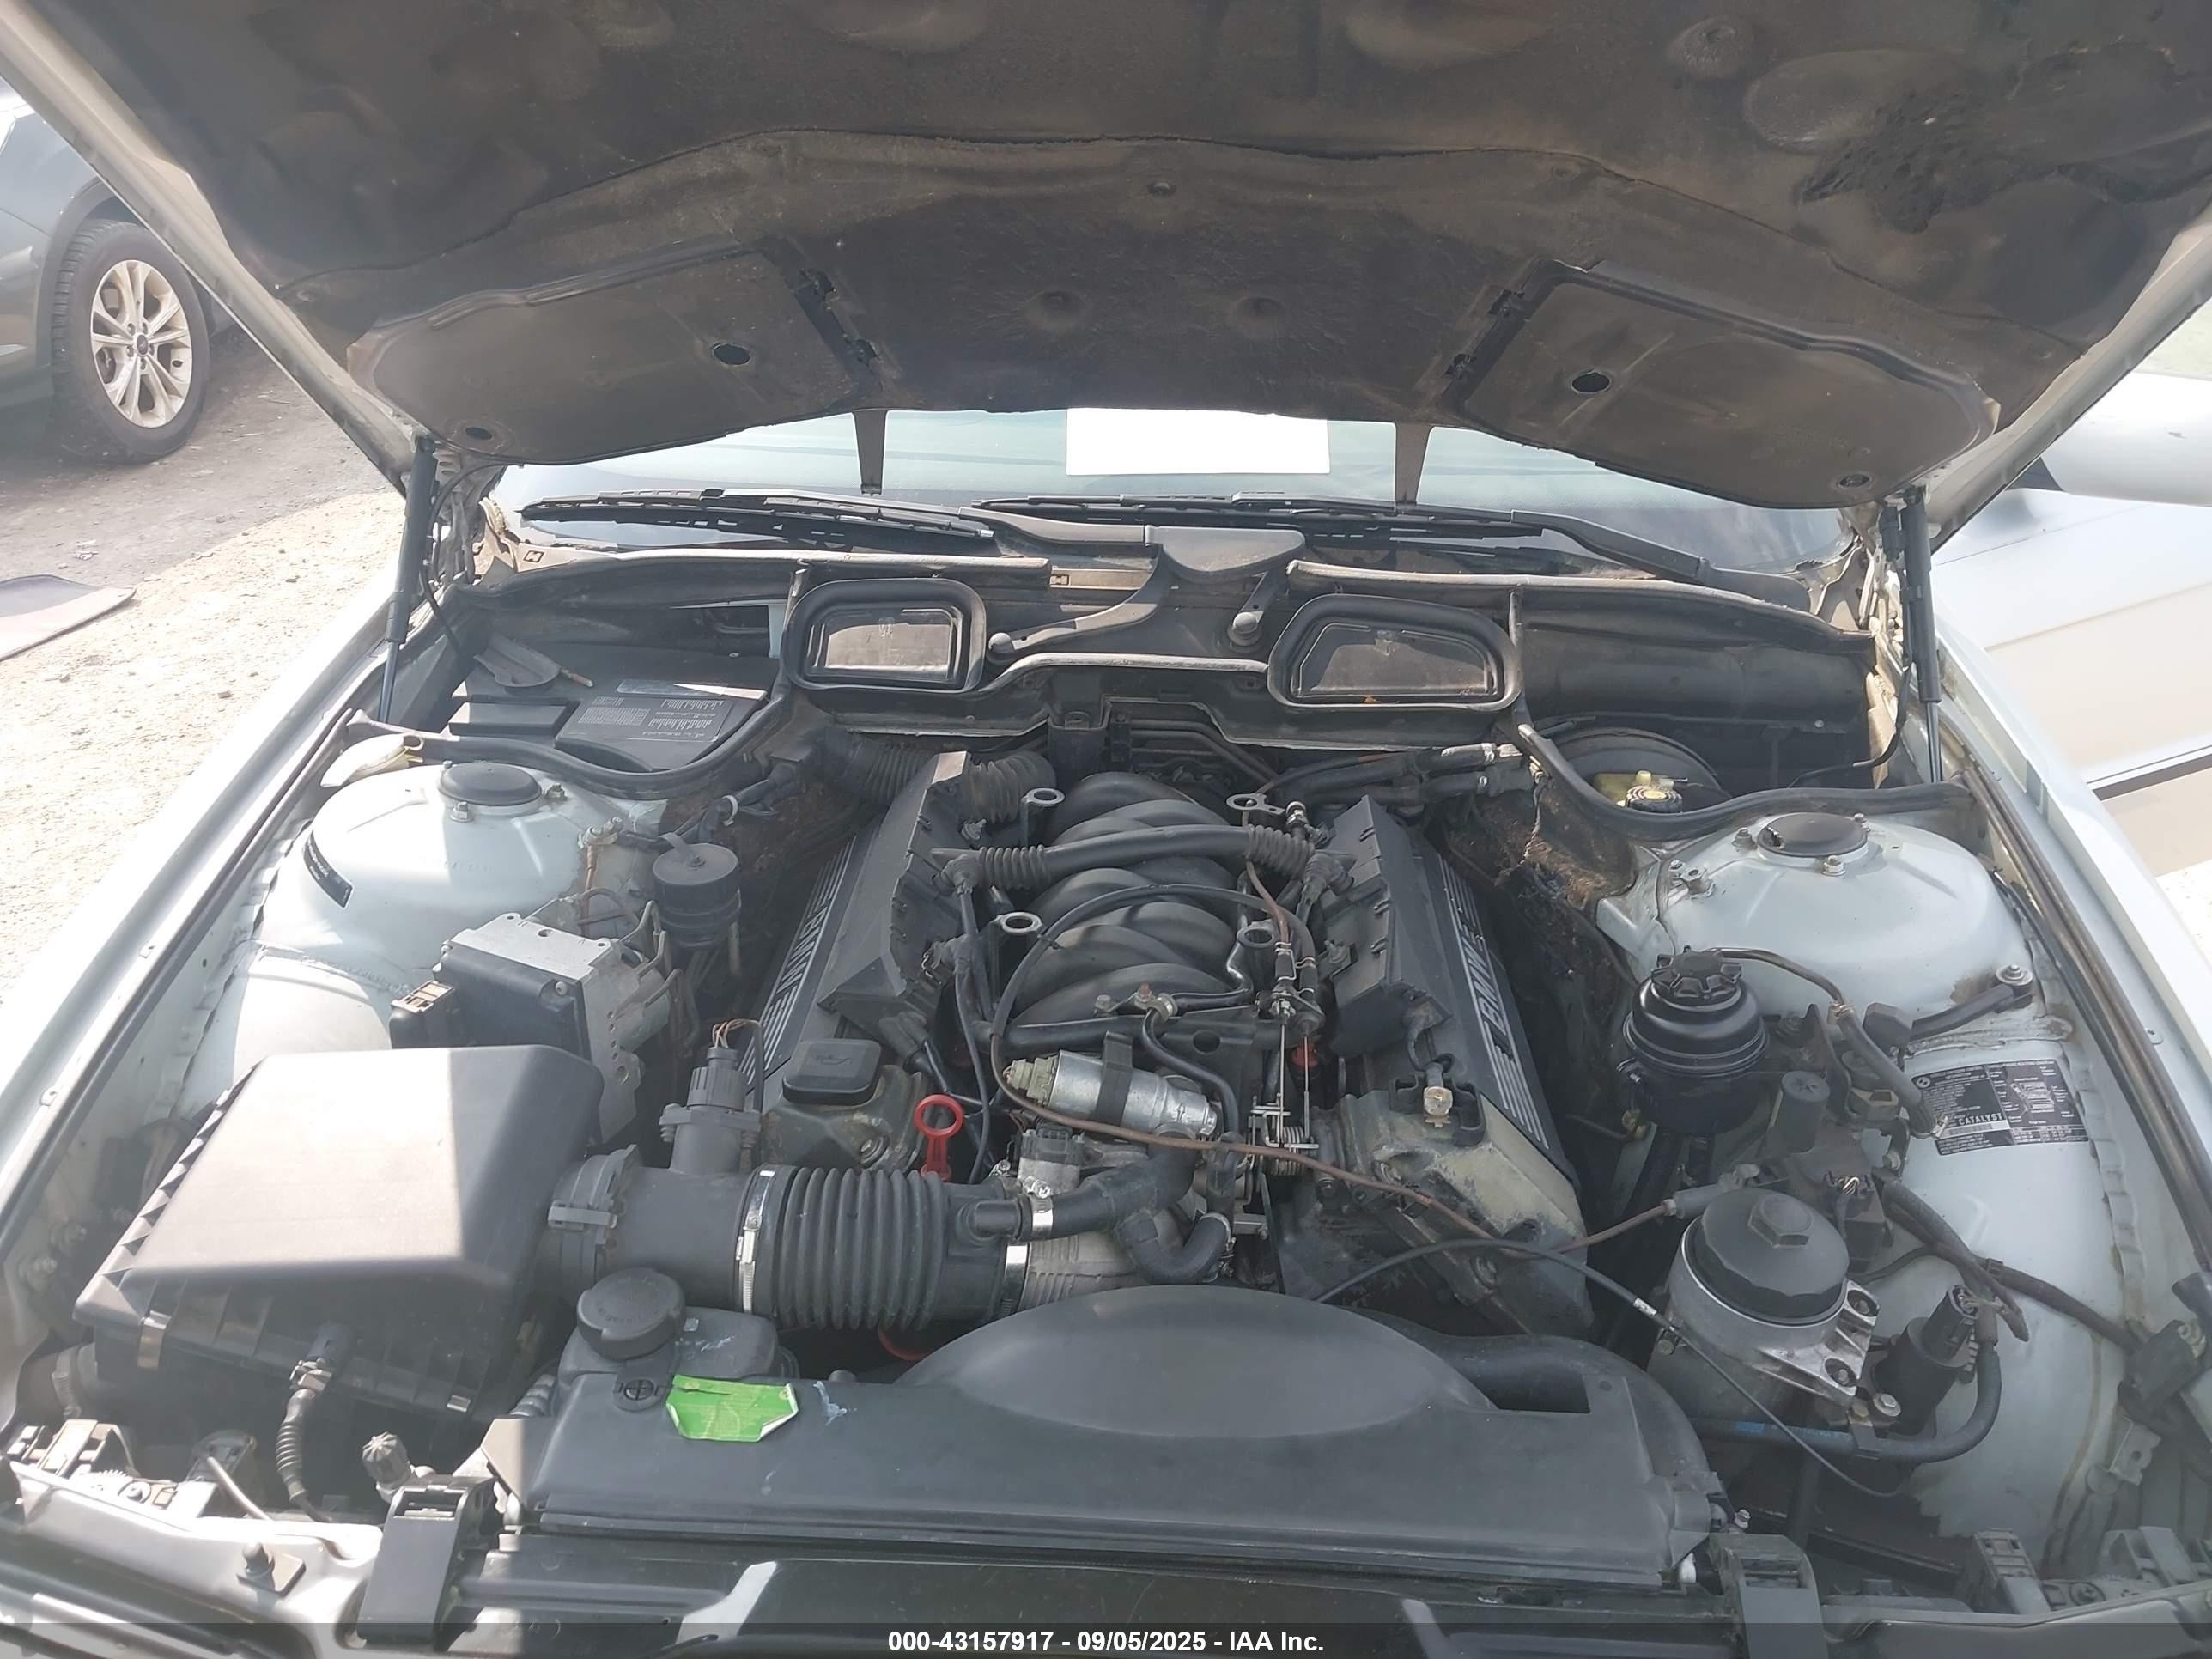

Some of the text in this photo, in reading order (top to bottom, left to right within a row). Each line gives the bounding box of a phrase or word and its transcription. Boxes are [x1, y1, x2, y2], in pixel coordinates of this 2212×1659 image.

[775, 906, 827, 994] BMW
[1462, 935, 1506, 1036] BMW
[1958, 1113, 2002, 1125] CATALYST
